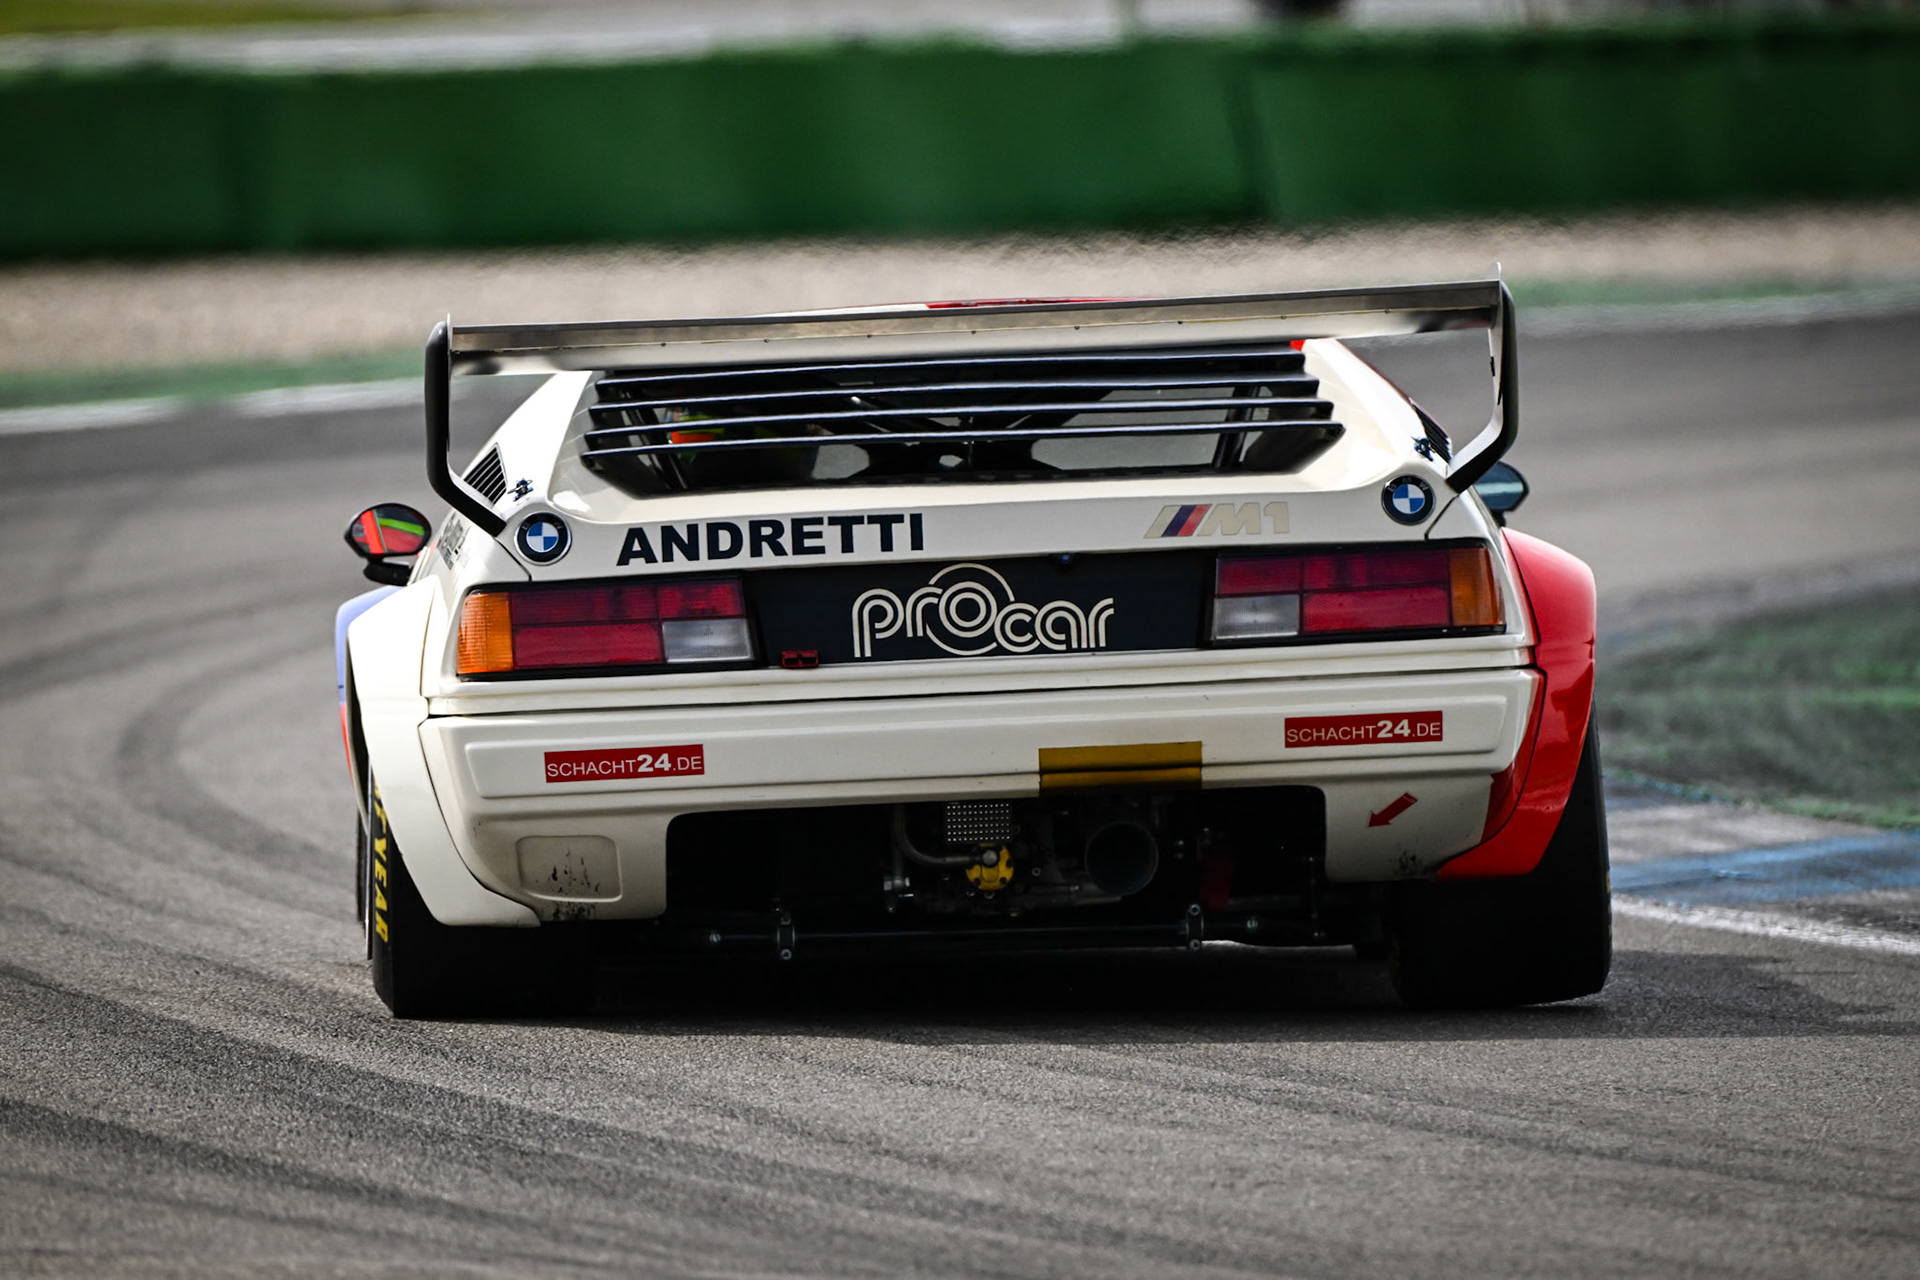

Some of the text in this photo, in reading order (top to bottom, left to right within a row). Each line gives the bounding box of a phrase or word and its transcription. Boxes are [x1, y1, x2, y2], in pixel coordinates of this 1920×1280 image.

[616, 513, 924, 566] ANDRETTI
[1286, 719, 1441, 743] SCHACHT24.DE
[547, 753, 702, 777] SCHACHT24.DE
